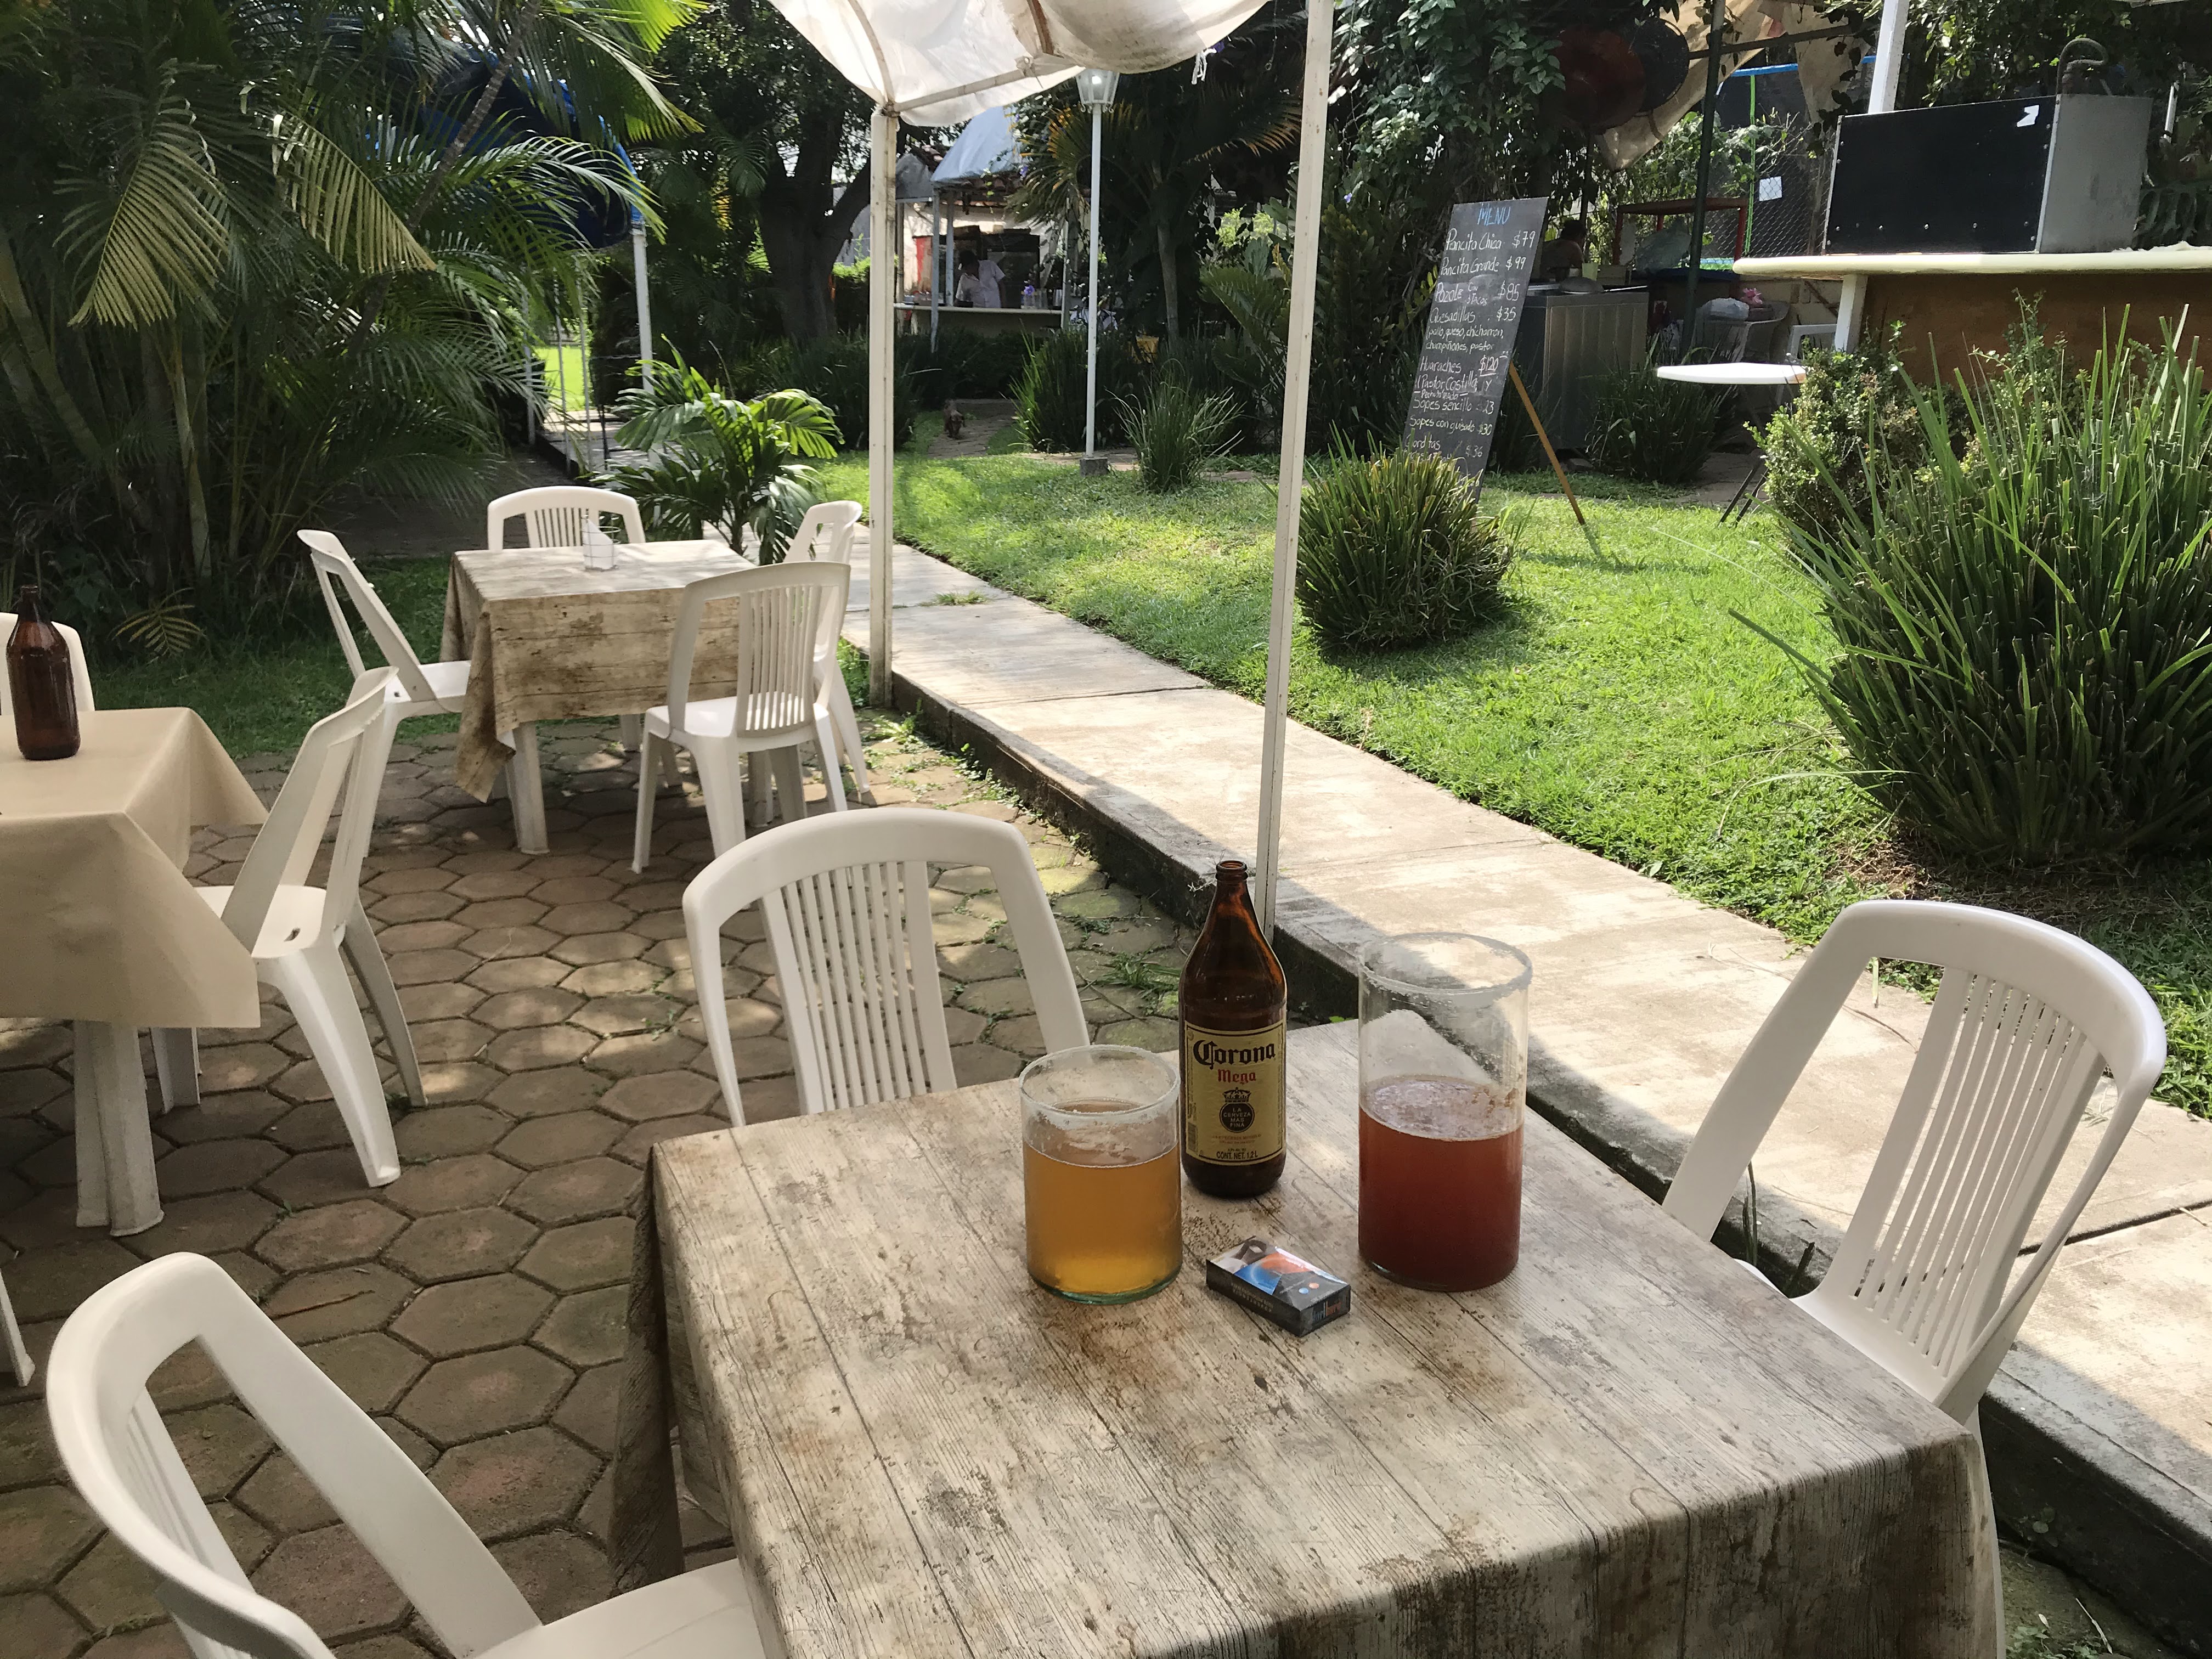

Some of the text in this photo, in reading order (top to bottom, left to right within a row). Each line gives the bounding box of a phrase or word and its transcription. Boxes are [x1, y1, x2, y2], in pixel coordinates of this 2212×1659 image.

[1477, 204, 1511, 226] MENU
[1446, 228, 1536, 251] Pancita Chica $79
[1440, 255, 1526, 275] Pancita Grande $99
[1429, 306, 1516, 324] Quesadillas $35
[1470, 340, 1494, 354] pastor
[1420, 354, 1499, 375] Huaraches $120
[1413, 398, 1440, 413] Sopes
[1442, 397, 1472, 411] sencillo
[1409, 414, 1434, 430] Sopes
[1436, 420, 1449, 428] con
[1450, 419, 1475, 435] guisado
[1404, 434, 1441, 450] Gordtas
[1193, 1040, 1276, 1070] Corona
[1217, 1069, 1256, 1085] Mega
